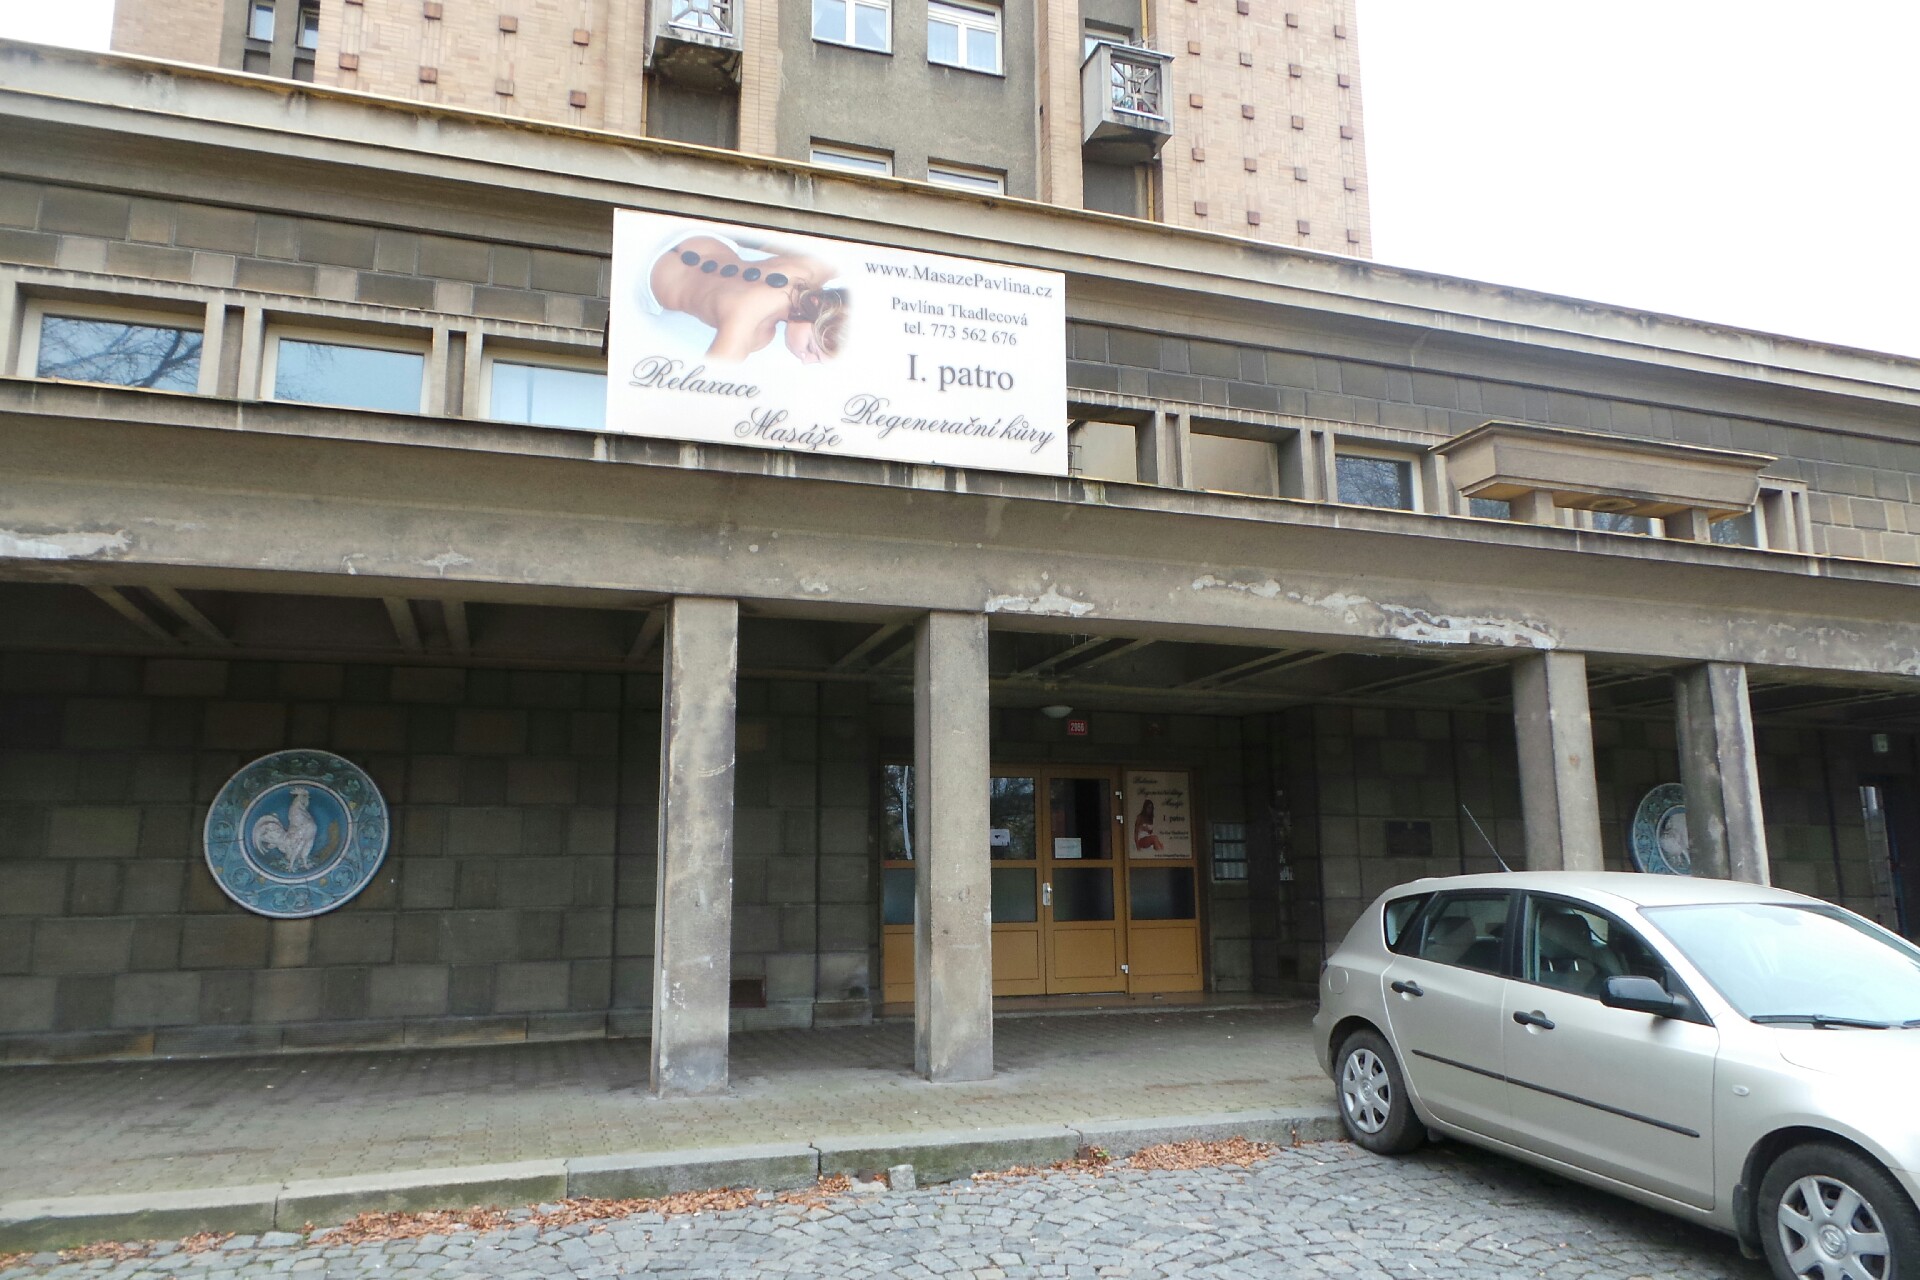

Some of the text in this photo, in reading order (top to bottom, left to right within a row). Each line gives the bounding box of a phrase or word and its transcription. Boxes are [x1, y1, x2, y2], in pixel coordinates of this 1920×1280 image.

[865, 262, 1053, 298] www.MasazePavlina.cz
[891, 297, 1028, 326] Pavlína Tkadlecová
[904, 321, 1017, 346] tel. 773 562 676
[628, 355, 761, 398] Relaxace
[907, 353, 1014, 392] I. patro
[734, 406, 843, 450] Masáže
[840, 393, 1056, 454] Regenerační kůry
